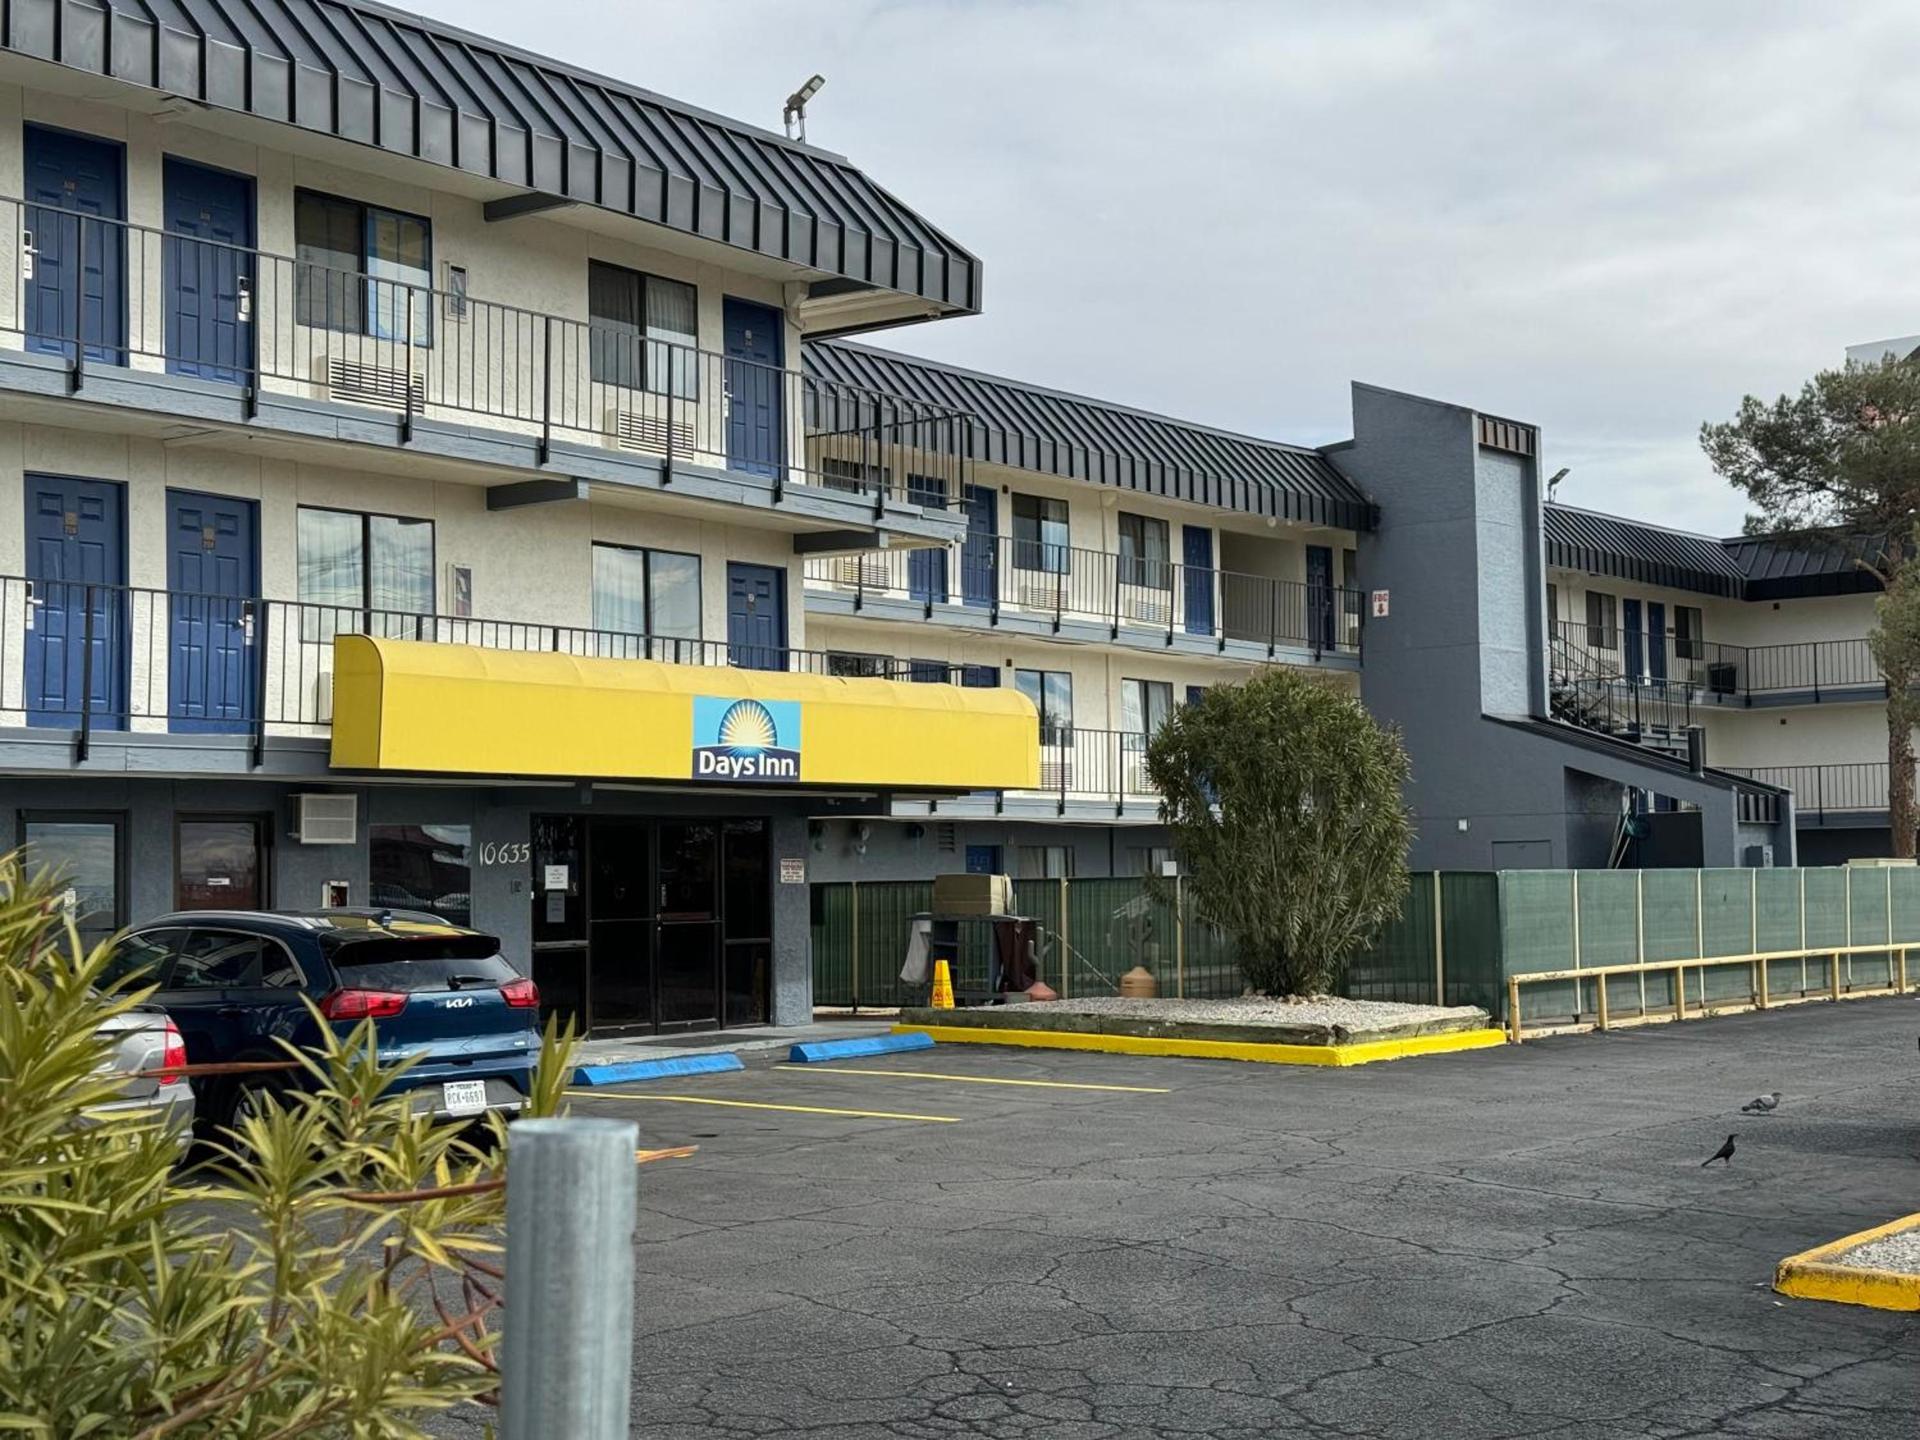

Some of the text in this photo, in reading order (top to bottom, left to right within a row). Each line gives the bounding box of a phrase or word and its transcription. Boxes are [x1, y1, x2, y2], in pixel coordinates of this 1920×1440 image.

[699, 751, 795, 779] Days Inn
[479, 842, 531, 866] 10635
